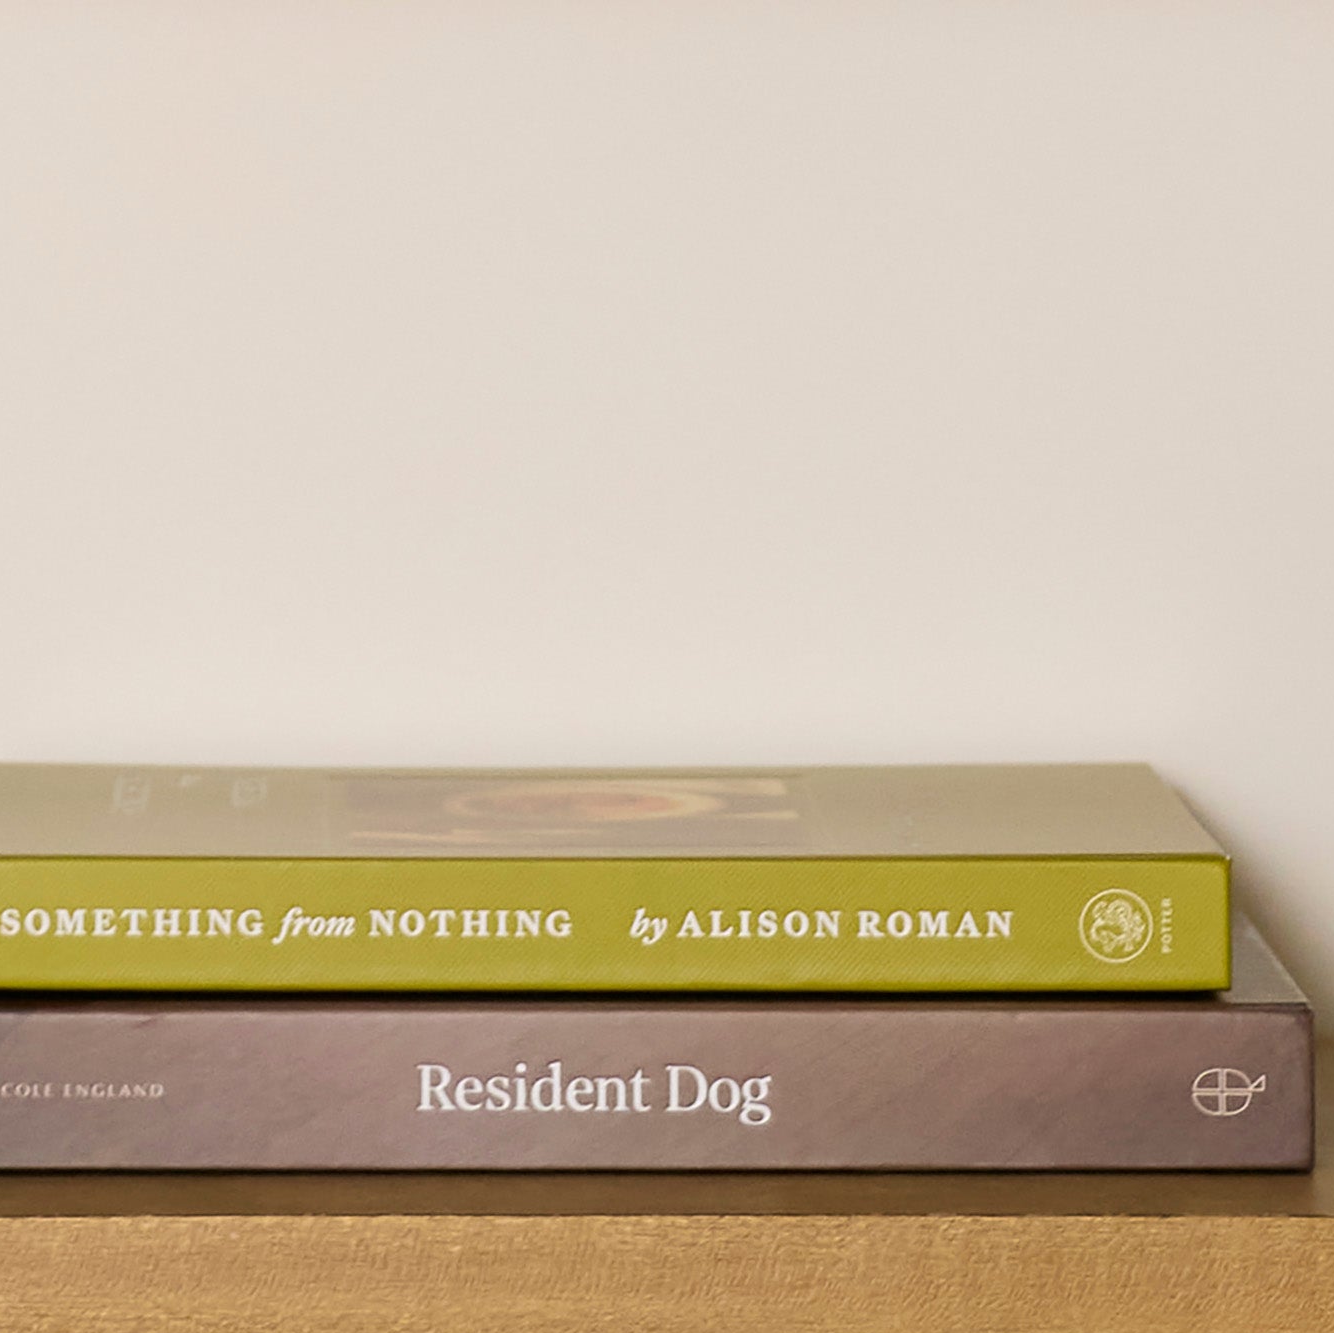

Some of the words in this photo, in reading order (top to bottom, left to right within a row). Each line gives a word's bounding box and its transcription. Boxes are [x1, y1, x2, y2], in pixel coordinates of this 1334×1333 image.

[0, 908, 265, 938] SOMETHING
[270, 906, 356, 945] from
[368, 909, 573, 938] NOTHING
[629, 907, 668, 945] by
[676, 909, 842, 939] ALISON
[857, 910, 1014, 939] ROMAN
[1161, 898, 1172, 954] POTTER
[63, 1082, 165, 1098] ENGLAND
[416, 1061, 652, 1112] Resident
[665, 1064, 772, 1126] Dog
